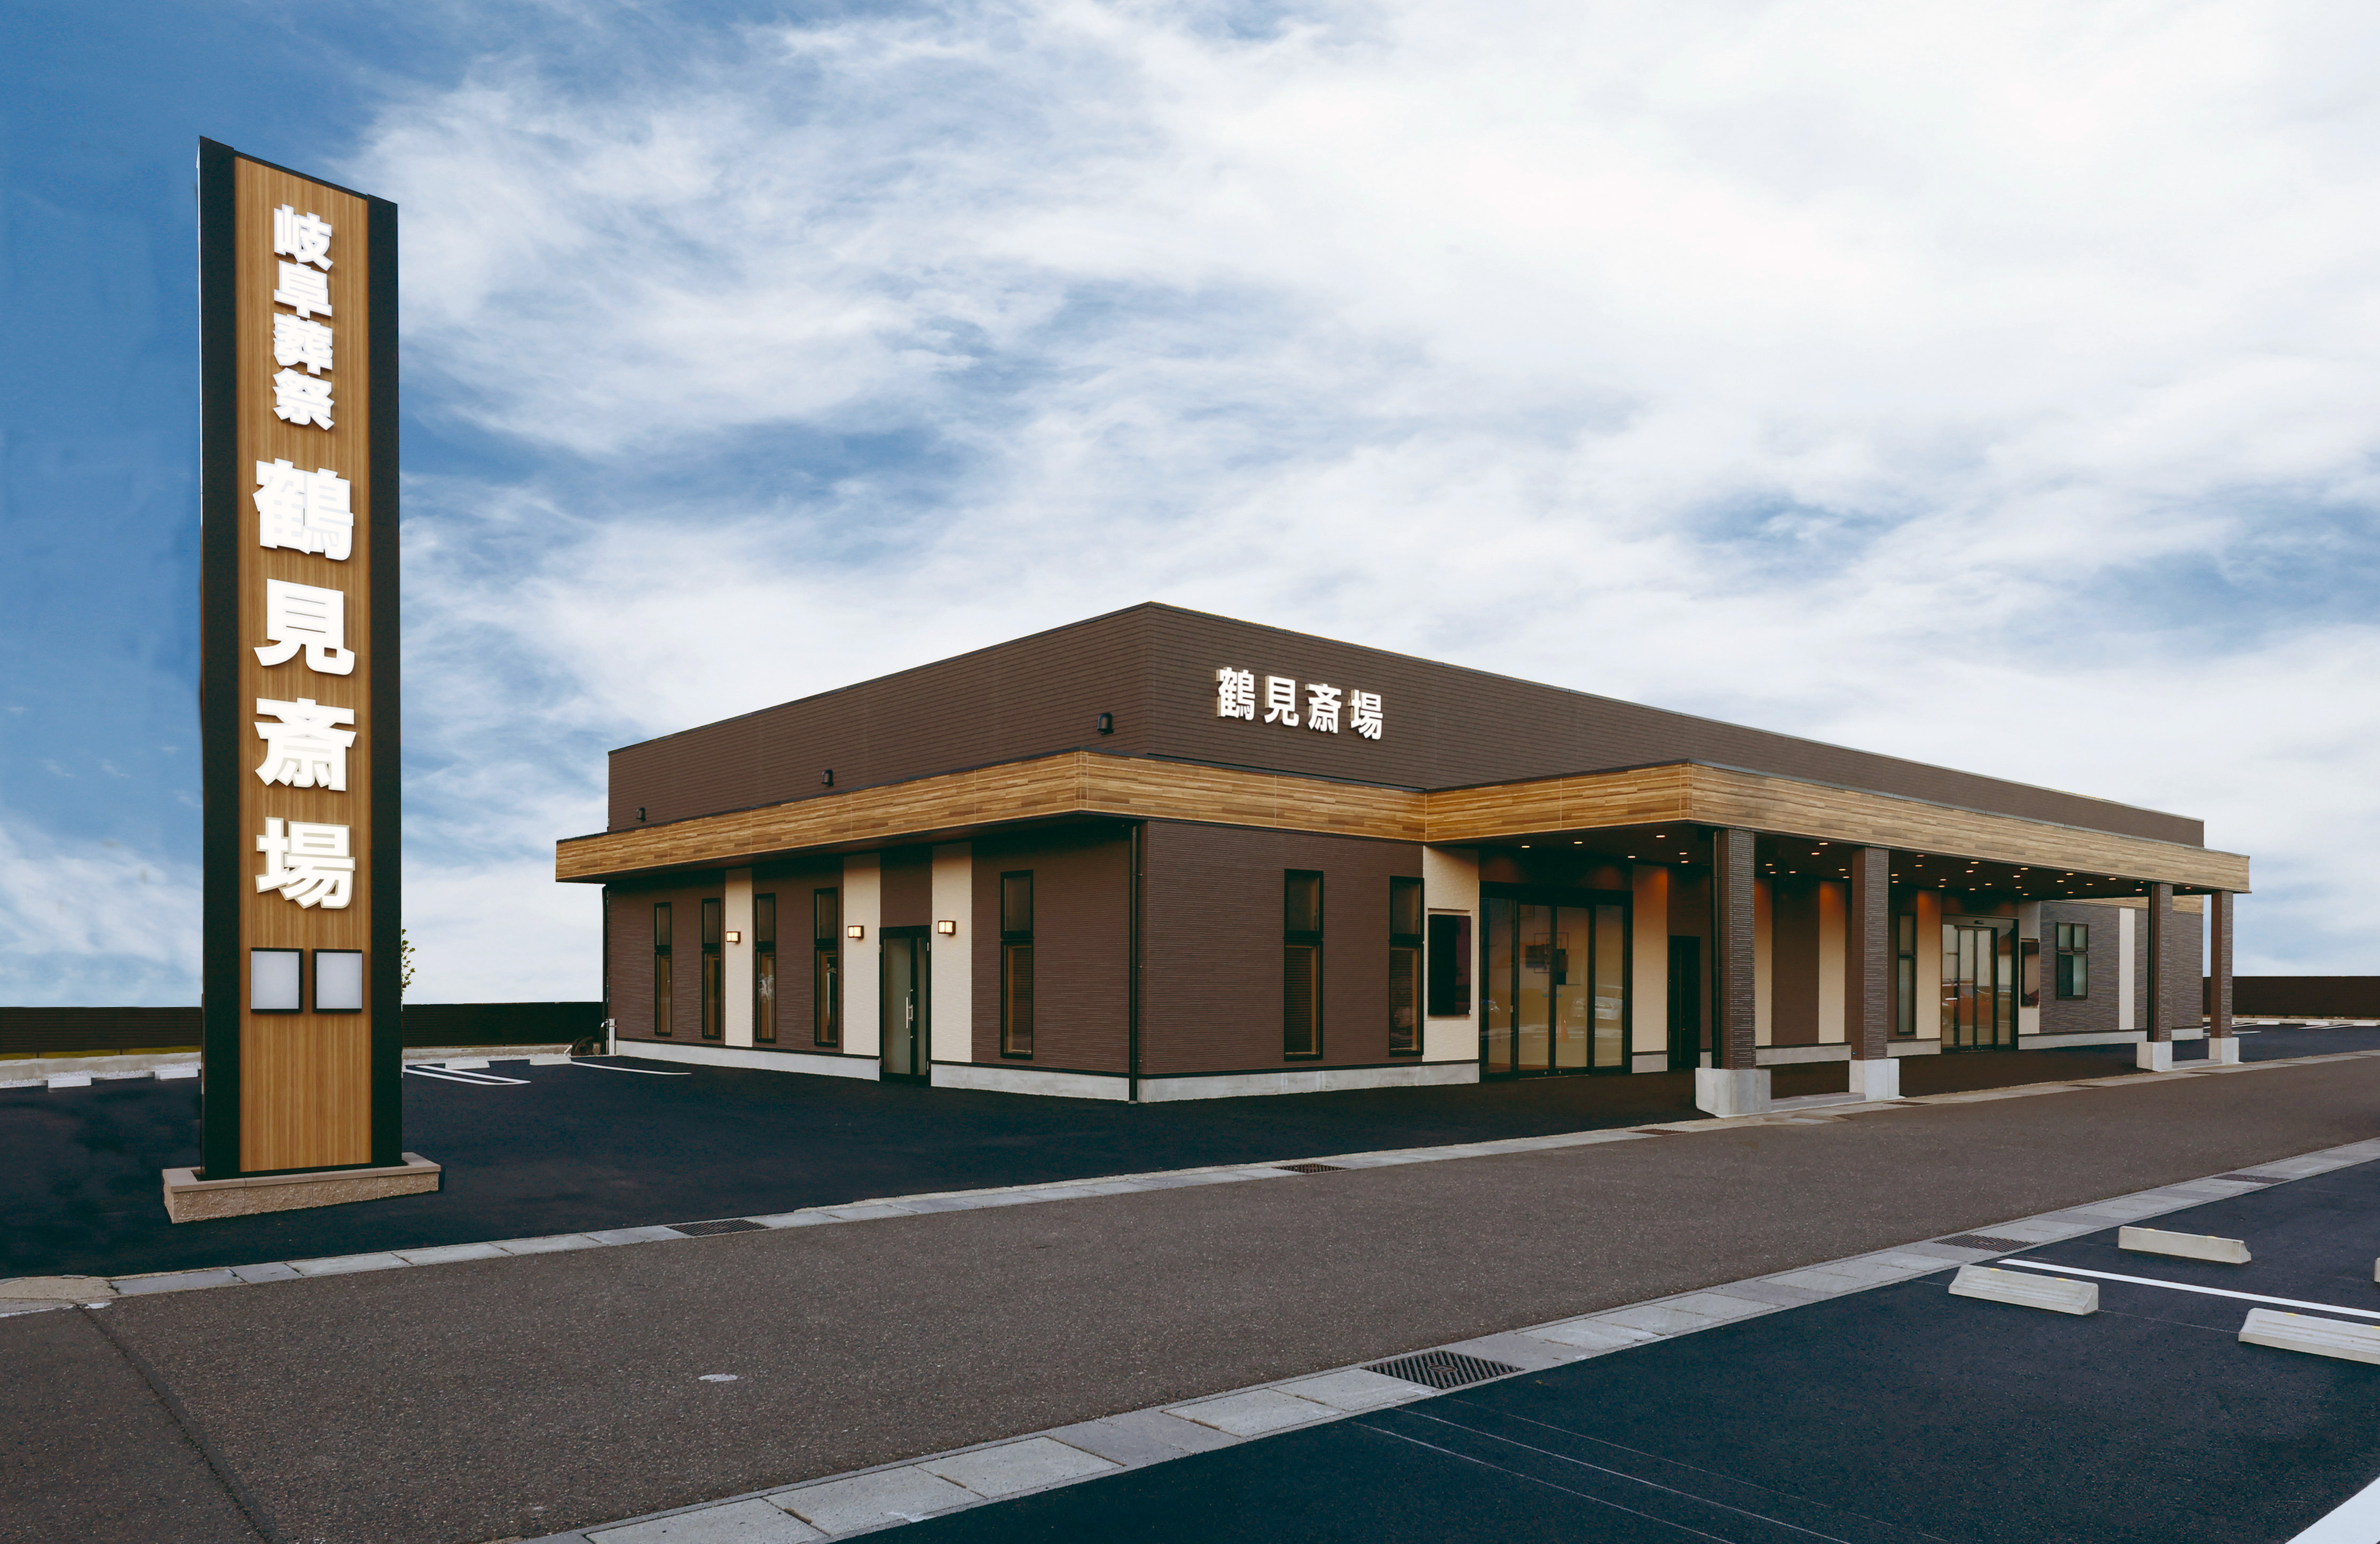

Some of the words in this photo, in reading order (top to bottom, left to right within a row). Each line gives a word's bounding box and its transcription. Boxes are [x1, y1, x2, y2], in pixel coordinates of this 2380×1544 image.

[273, 203, 335, 431] 岐阜葬祭
[253, 458, 357, 909] 鶴見斎場
[1216, 667, 1383, 740] 鶴見斎場
